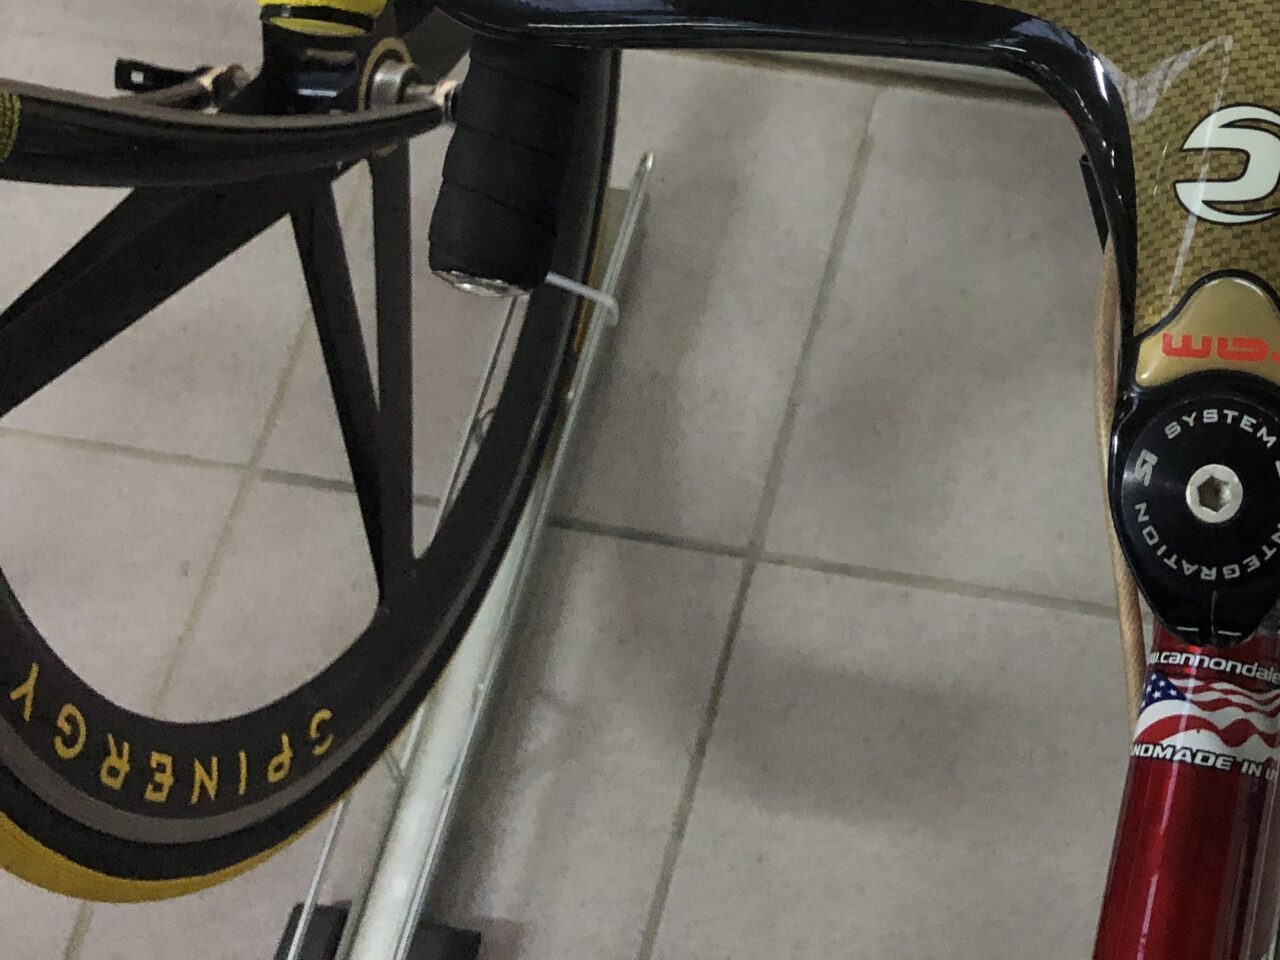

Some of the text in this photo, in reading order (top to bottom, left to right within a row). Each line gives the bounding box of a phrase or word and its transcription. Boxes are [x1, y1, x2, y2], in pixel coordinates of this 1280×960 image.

[1164, 408, 1277, 448] SYSTEM
[9, 662, 334, 805] SPINERGY
[1240, 761, 1263, 778] IN
